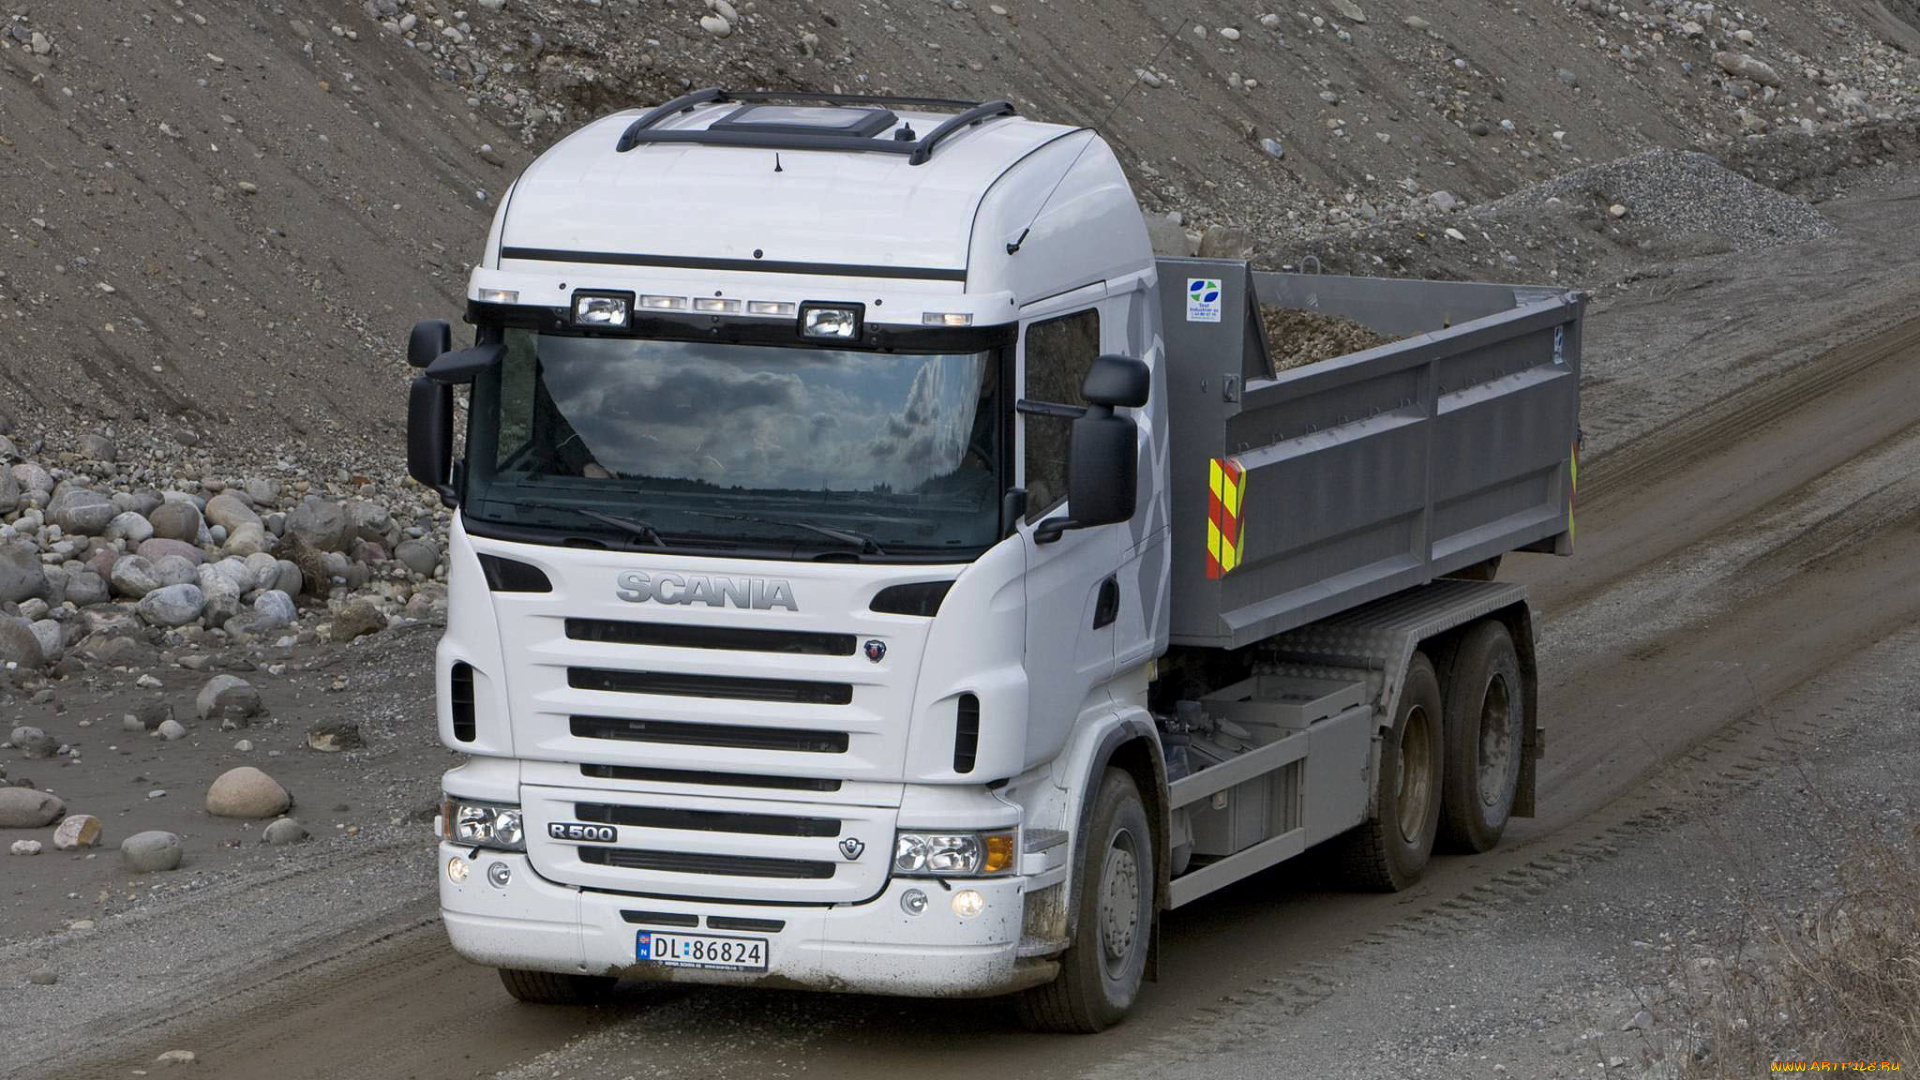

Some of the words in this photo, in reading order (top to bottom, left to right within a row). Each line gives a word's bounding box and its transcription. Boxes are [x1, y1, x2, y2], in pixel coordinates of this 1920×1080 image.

[616, 570, 799, 612] SCANIA
[551, 824, 566, 838] R
[569, 825, 613, 841] 500
[655, 937, 681, 959] DL
[692, 940, 761, 964] 86824
